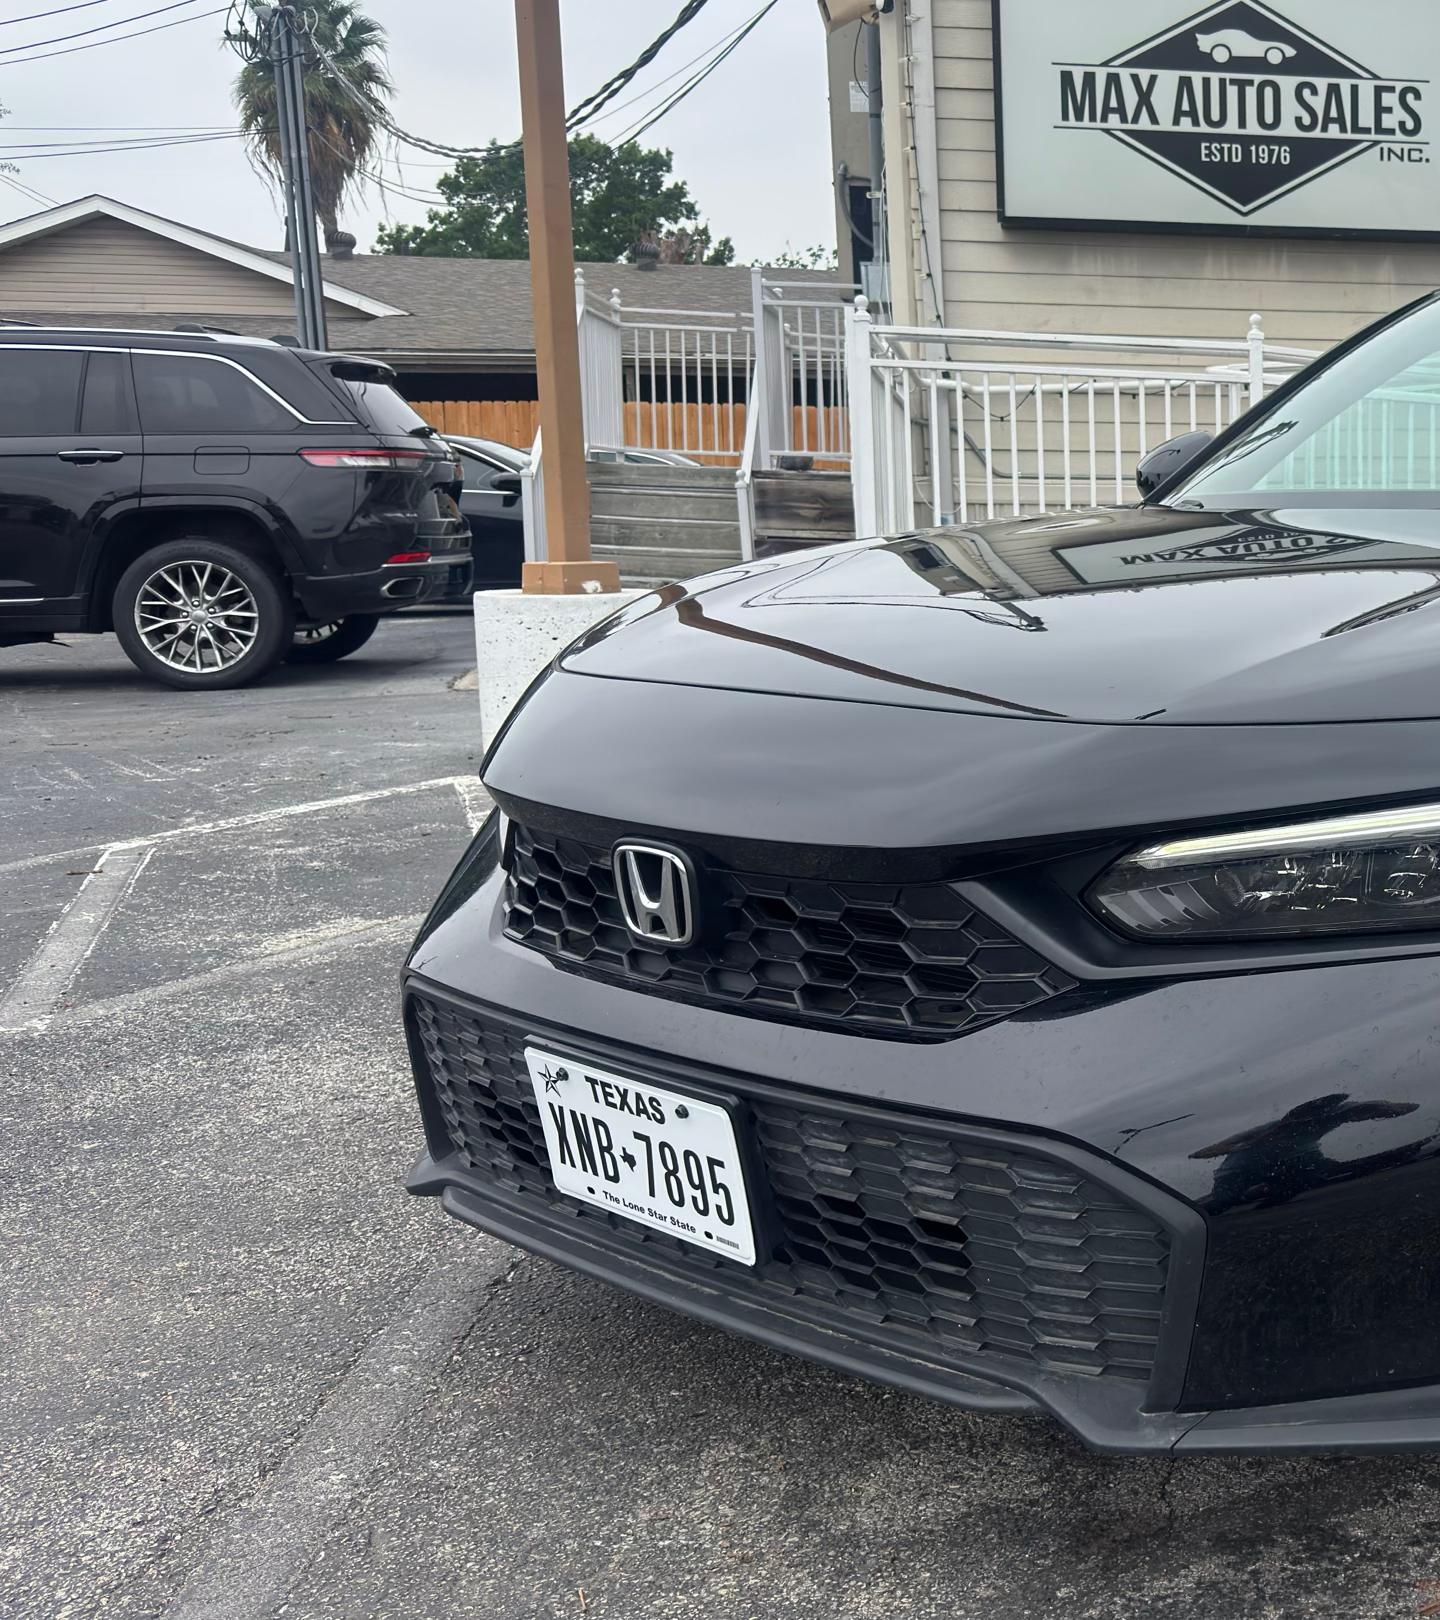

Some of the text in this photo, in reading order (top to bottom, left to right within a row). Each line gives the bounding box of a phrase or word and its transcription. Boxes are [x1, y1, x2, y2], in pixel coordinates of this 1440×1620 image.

[1059, 70, 1423, 138] MAX AUTO SALES
[1201, 143, 1291, 165] ESTD 1976
[1379, 147, 1431, 164] INC.
[584, 1075, 666, 1125] TEXAS
[632, 1130, 736, 1227] 7895
[602, 1190, 697, 1234] The Lone Star State
